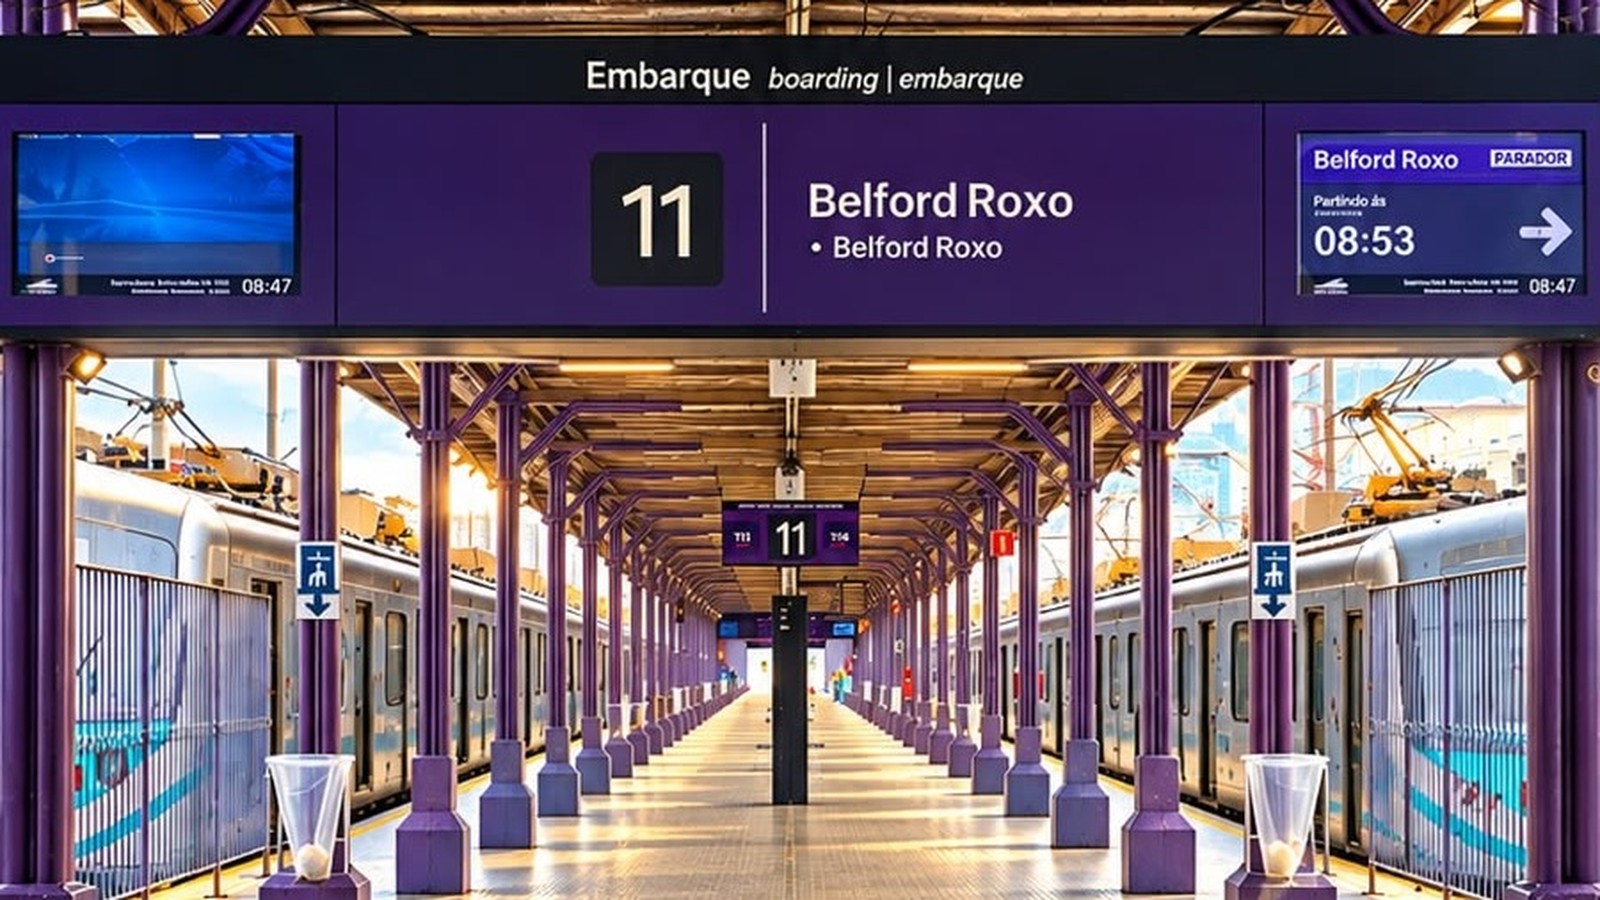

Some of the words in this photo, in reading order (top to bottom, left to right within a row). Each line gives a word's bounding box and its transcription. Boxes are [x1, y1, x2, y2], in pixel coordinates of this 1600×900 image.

[586, 60, 751, 97] Embarque
[768, 66, 879, 95] boarding
[899, 66, 1024, 95] embarque
[1314, 149, 1396, 170] Belford
[1402, 150, 1459, 170] Roxo
[1494, 152, 1568, 164] PARADOR
[809, 181, 958, 219] Belford
[968, 183, 1074, 219] Roxo
[1314, 194, 1369, 207] Partindo
[621, 184, 692, 258] 11
[833, 235, 929, 259] Belford
[936, 236, 1003, 259] Roxo
[1314, 225, 1416, 256] 08:53
[242, 278, 292, 295] 08:47
[1529, 277, 1577, 294] 08:47
[776, 521, 805, 556] 11
